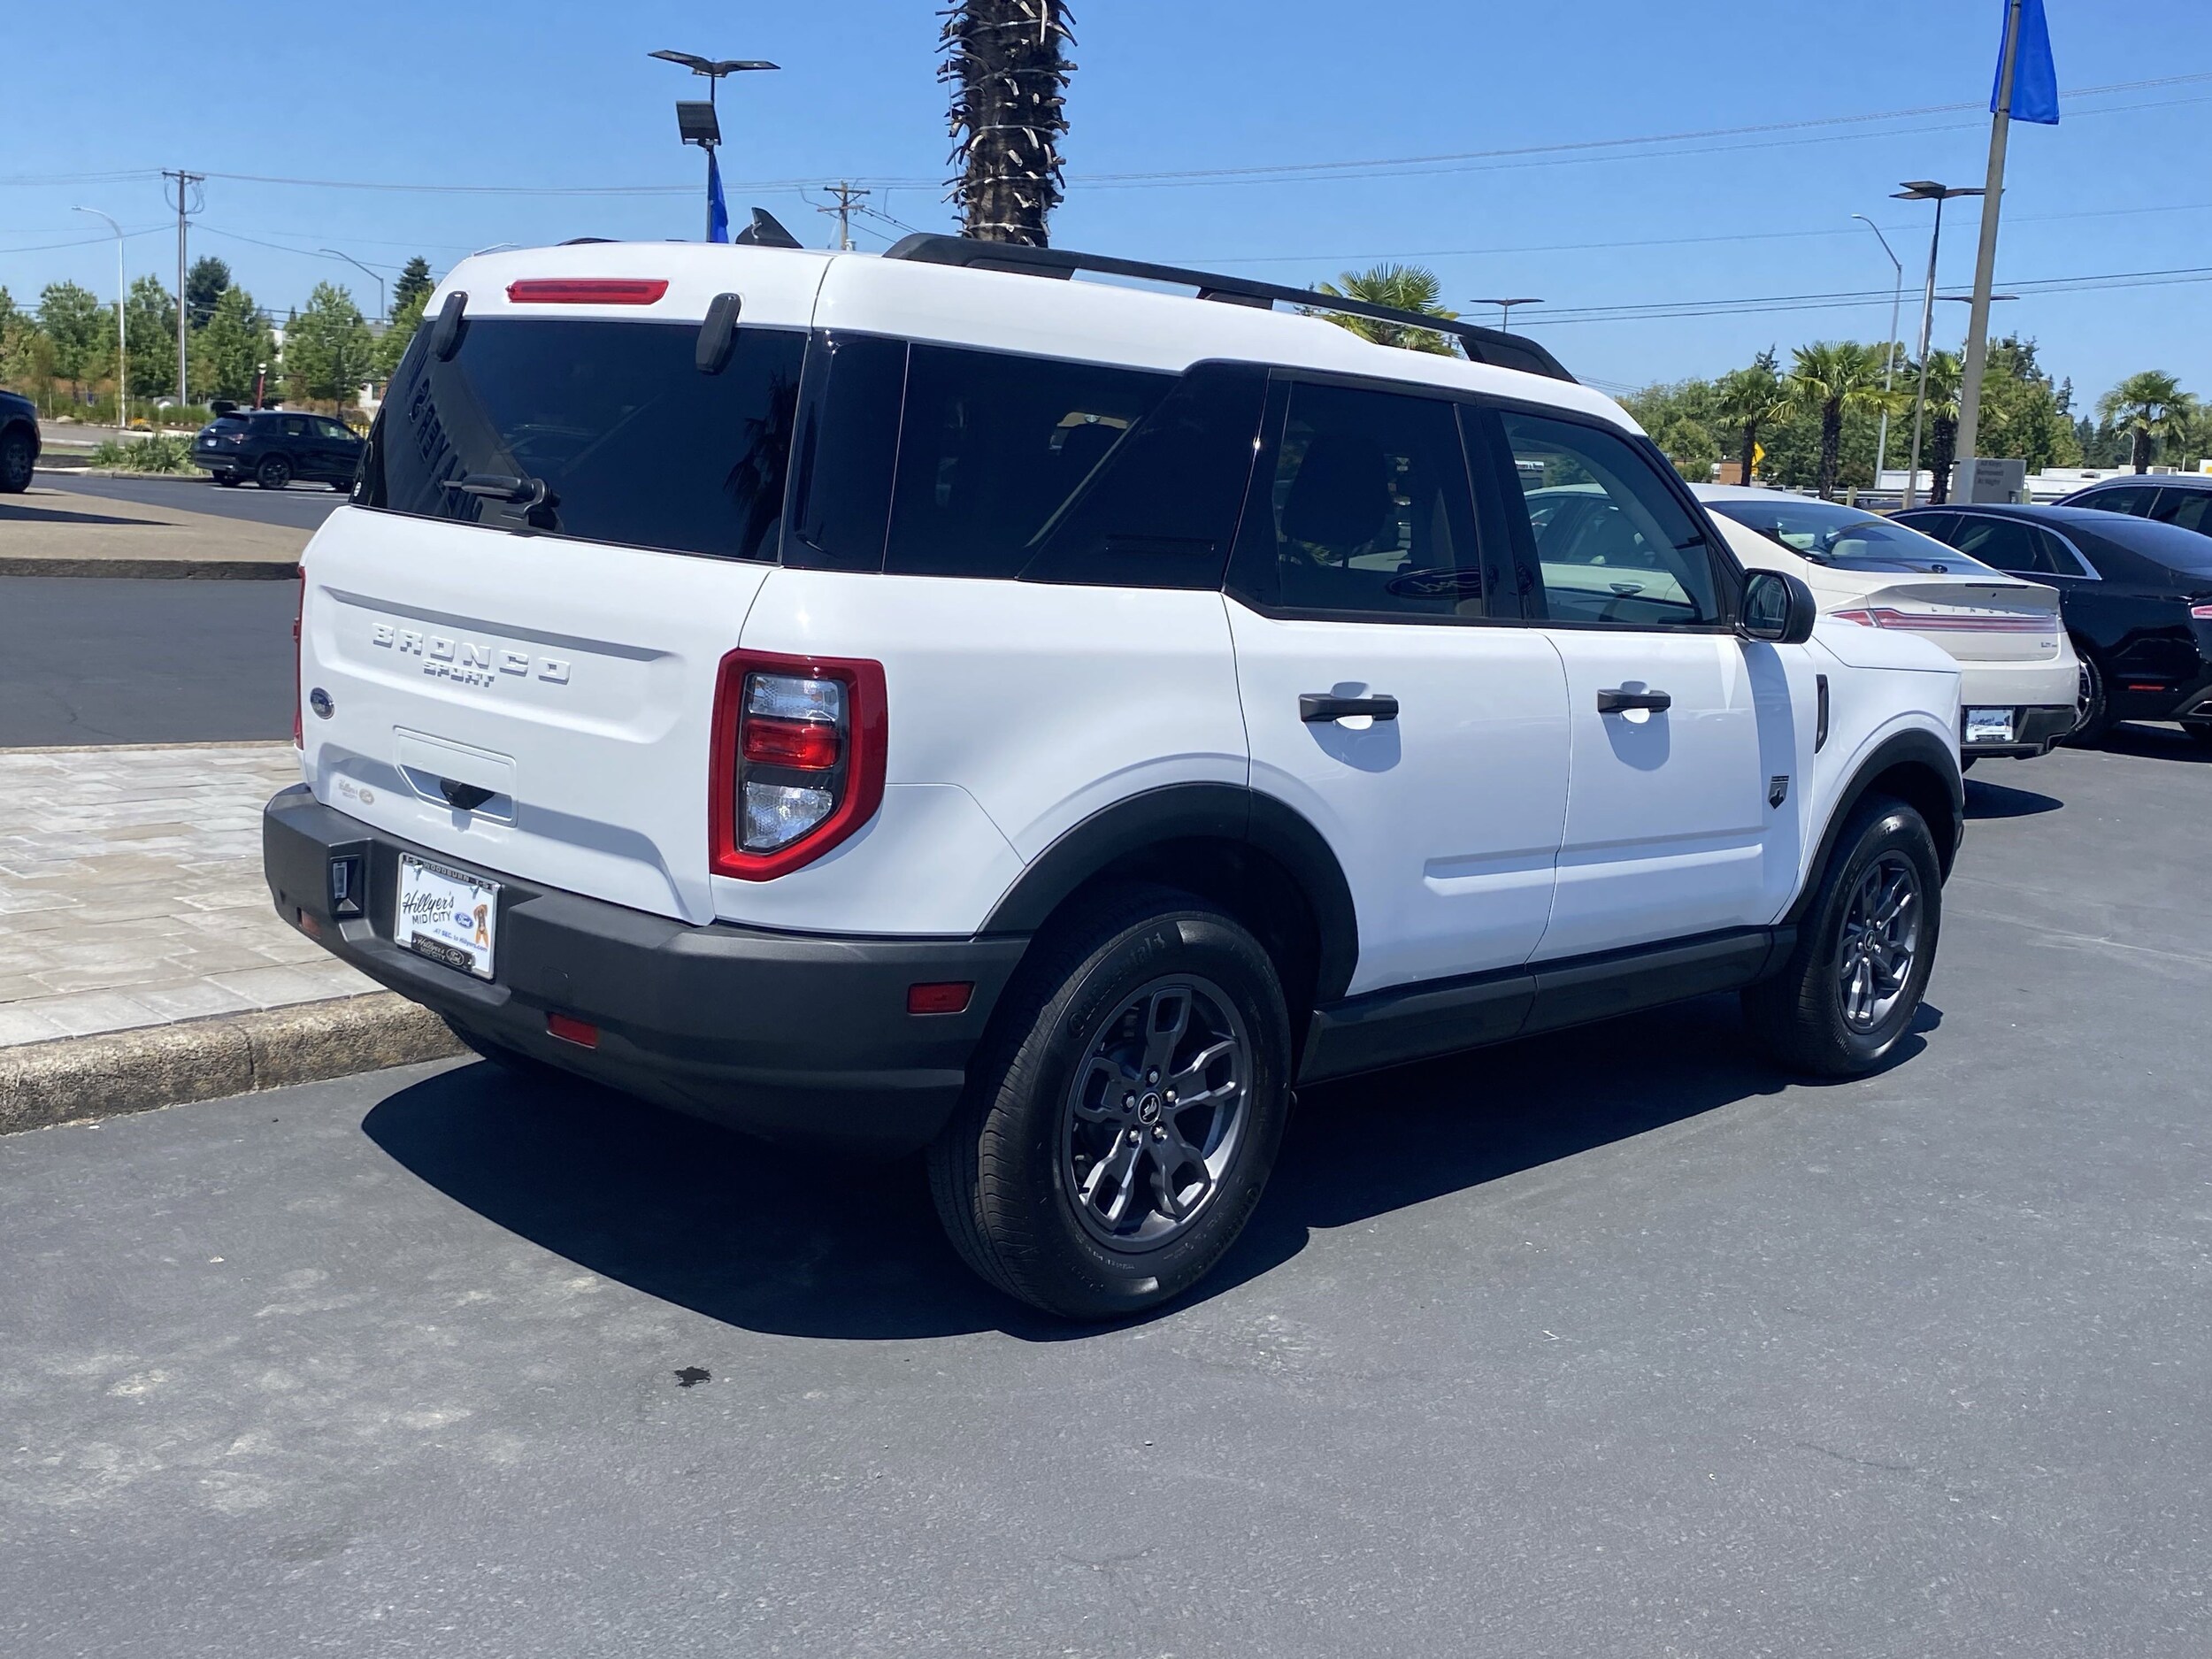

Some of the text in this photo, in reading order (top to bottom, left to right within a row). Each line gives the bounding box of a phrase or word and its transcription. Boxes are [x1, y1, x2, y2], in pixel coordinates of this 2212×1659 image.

[372, 622, 571, 686] BRONCO
[423, 659, 495, 687] SPORT
[423, 861, 470, 882] WOODBURN
[402, 889, 455, 925] Hillyer's
[411, 911, 452, 925] MID CITY
